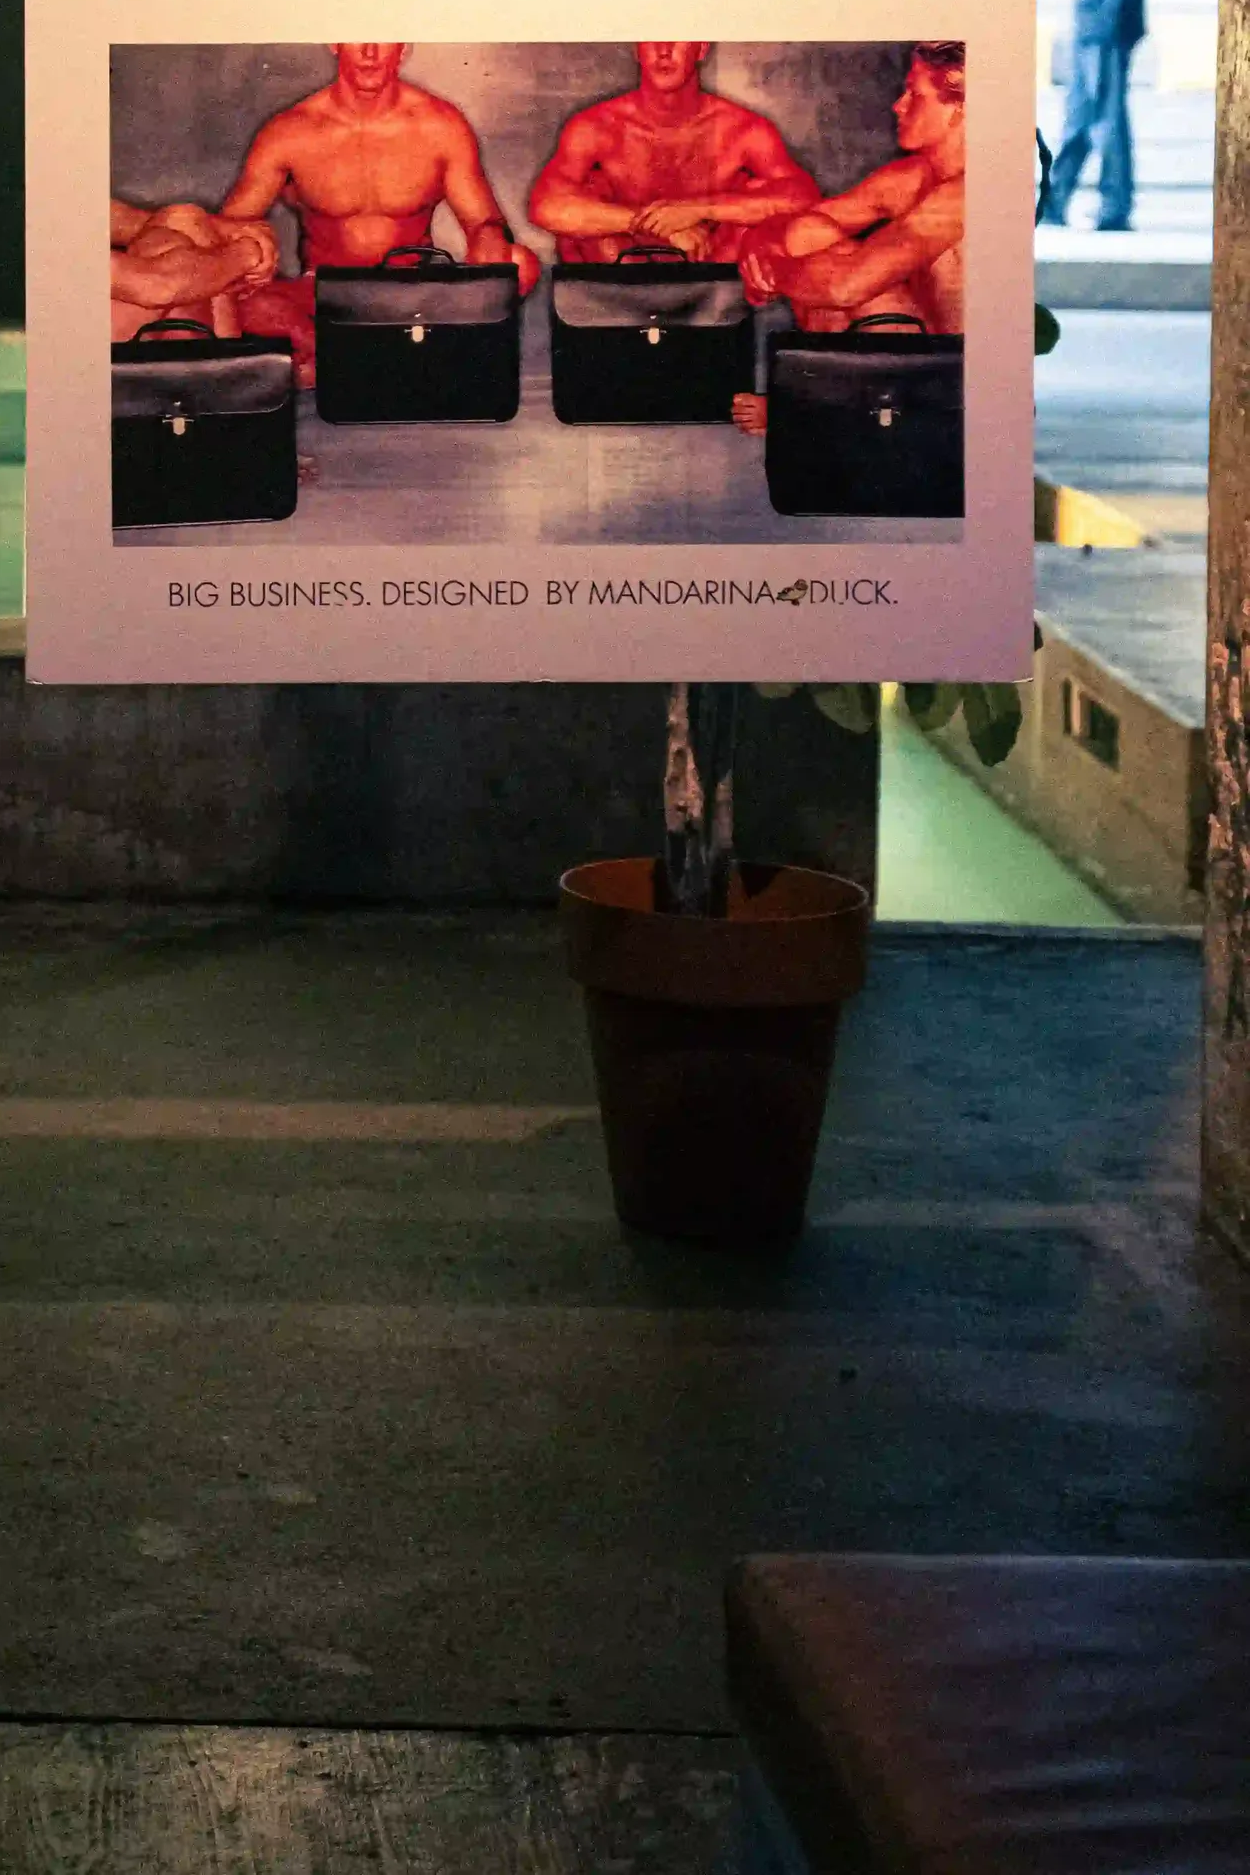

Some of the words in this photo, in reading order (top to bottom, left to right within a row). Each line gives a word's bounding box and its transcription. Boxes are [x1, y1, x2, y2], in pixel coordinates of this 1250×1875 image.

[168, 581, 220, 607] BIG
[230, 581, 372, 607] BUSINESS.
[382, 580, 529, 606] DESIGNED
[546, 580, 580, 605] BY
[588, 579, 776, 605] MANDARINA
[809, 578, 899, 605] DUCK.
